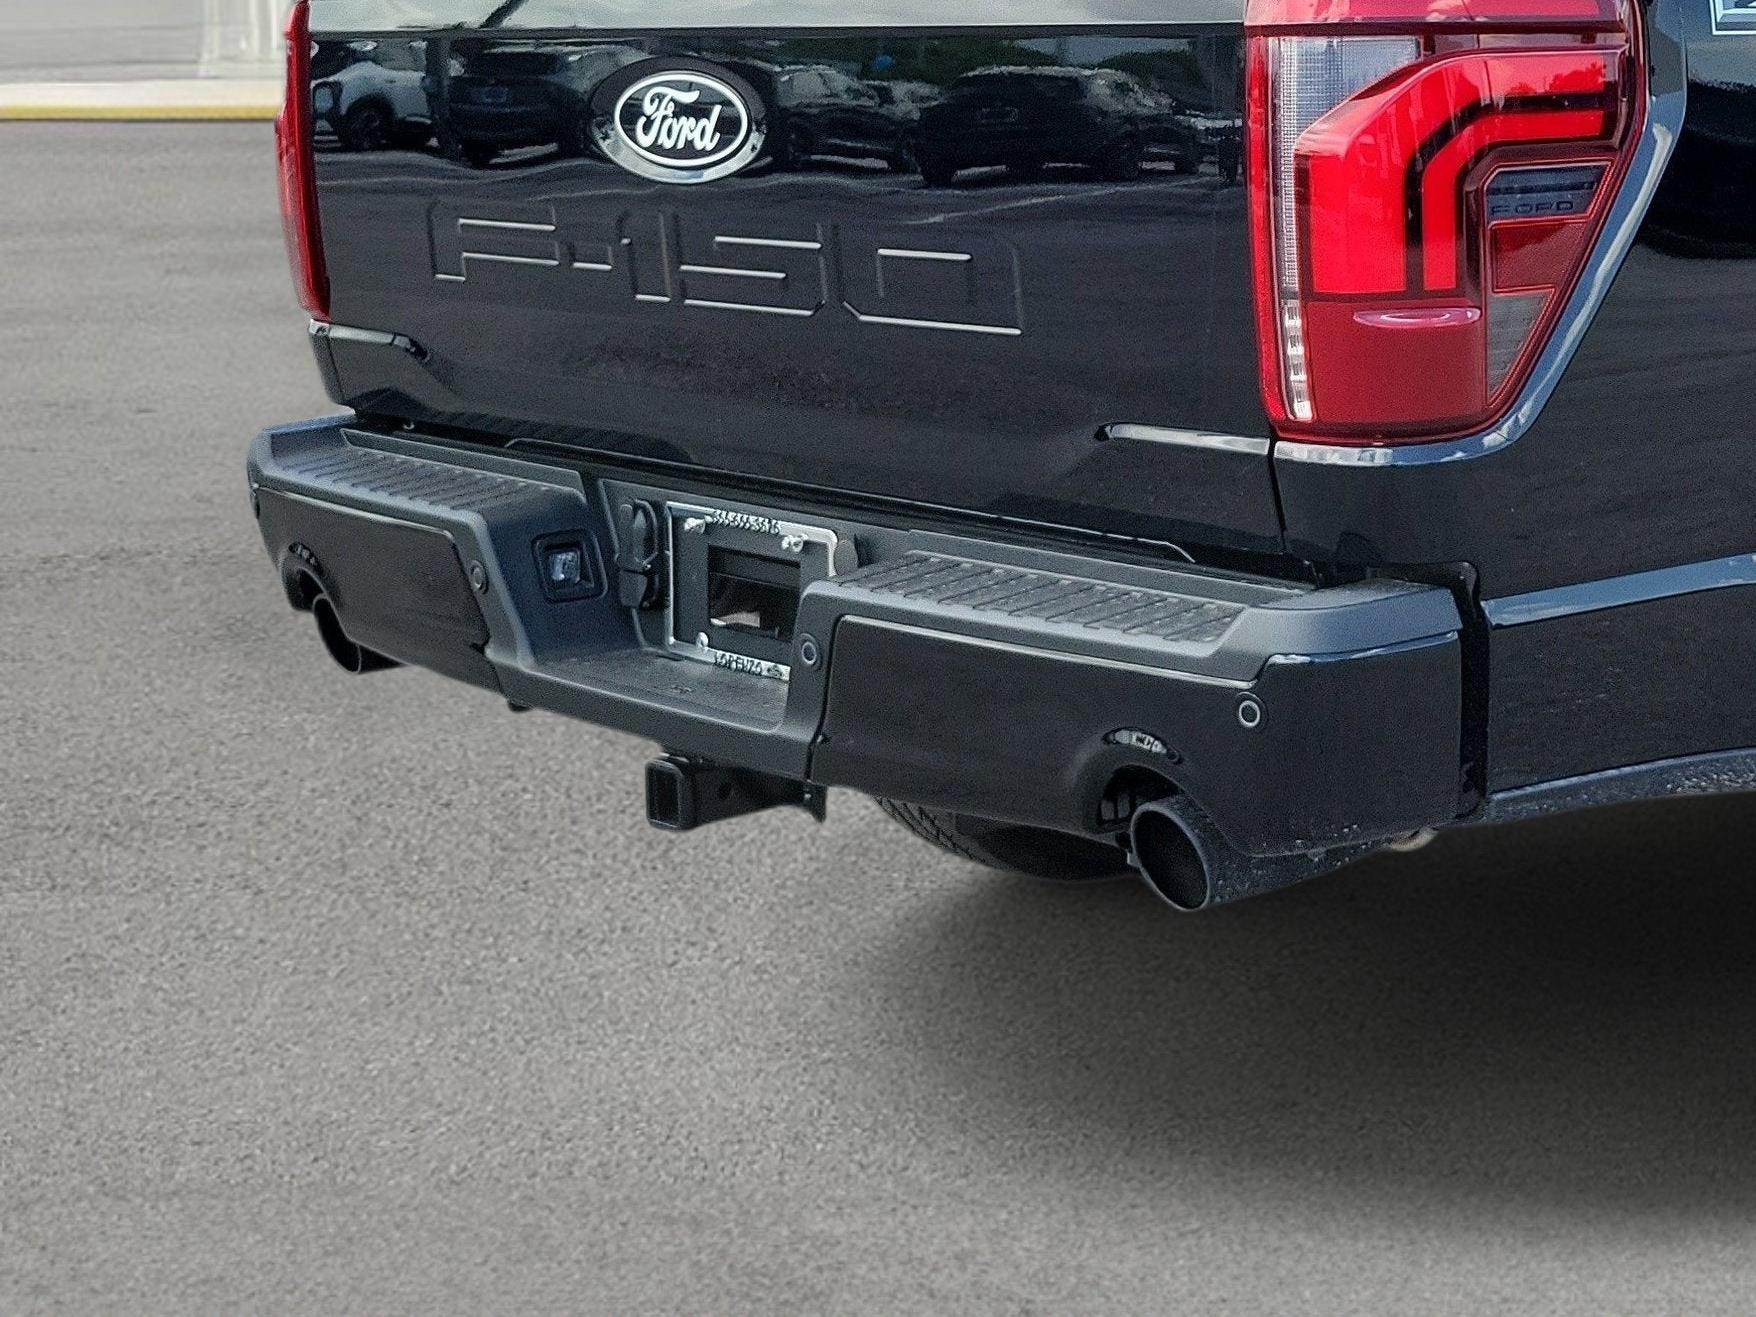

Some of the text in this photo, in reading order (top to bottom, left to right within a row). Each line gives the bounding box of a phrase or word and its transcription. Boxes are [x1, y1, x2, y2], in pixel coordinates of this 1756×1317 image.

[635, 86, 722, 152] Ford
[1491, 200, 1574, 216] FORD
[427, 199, 1023, 335] F-150
